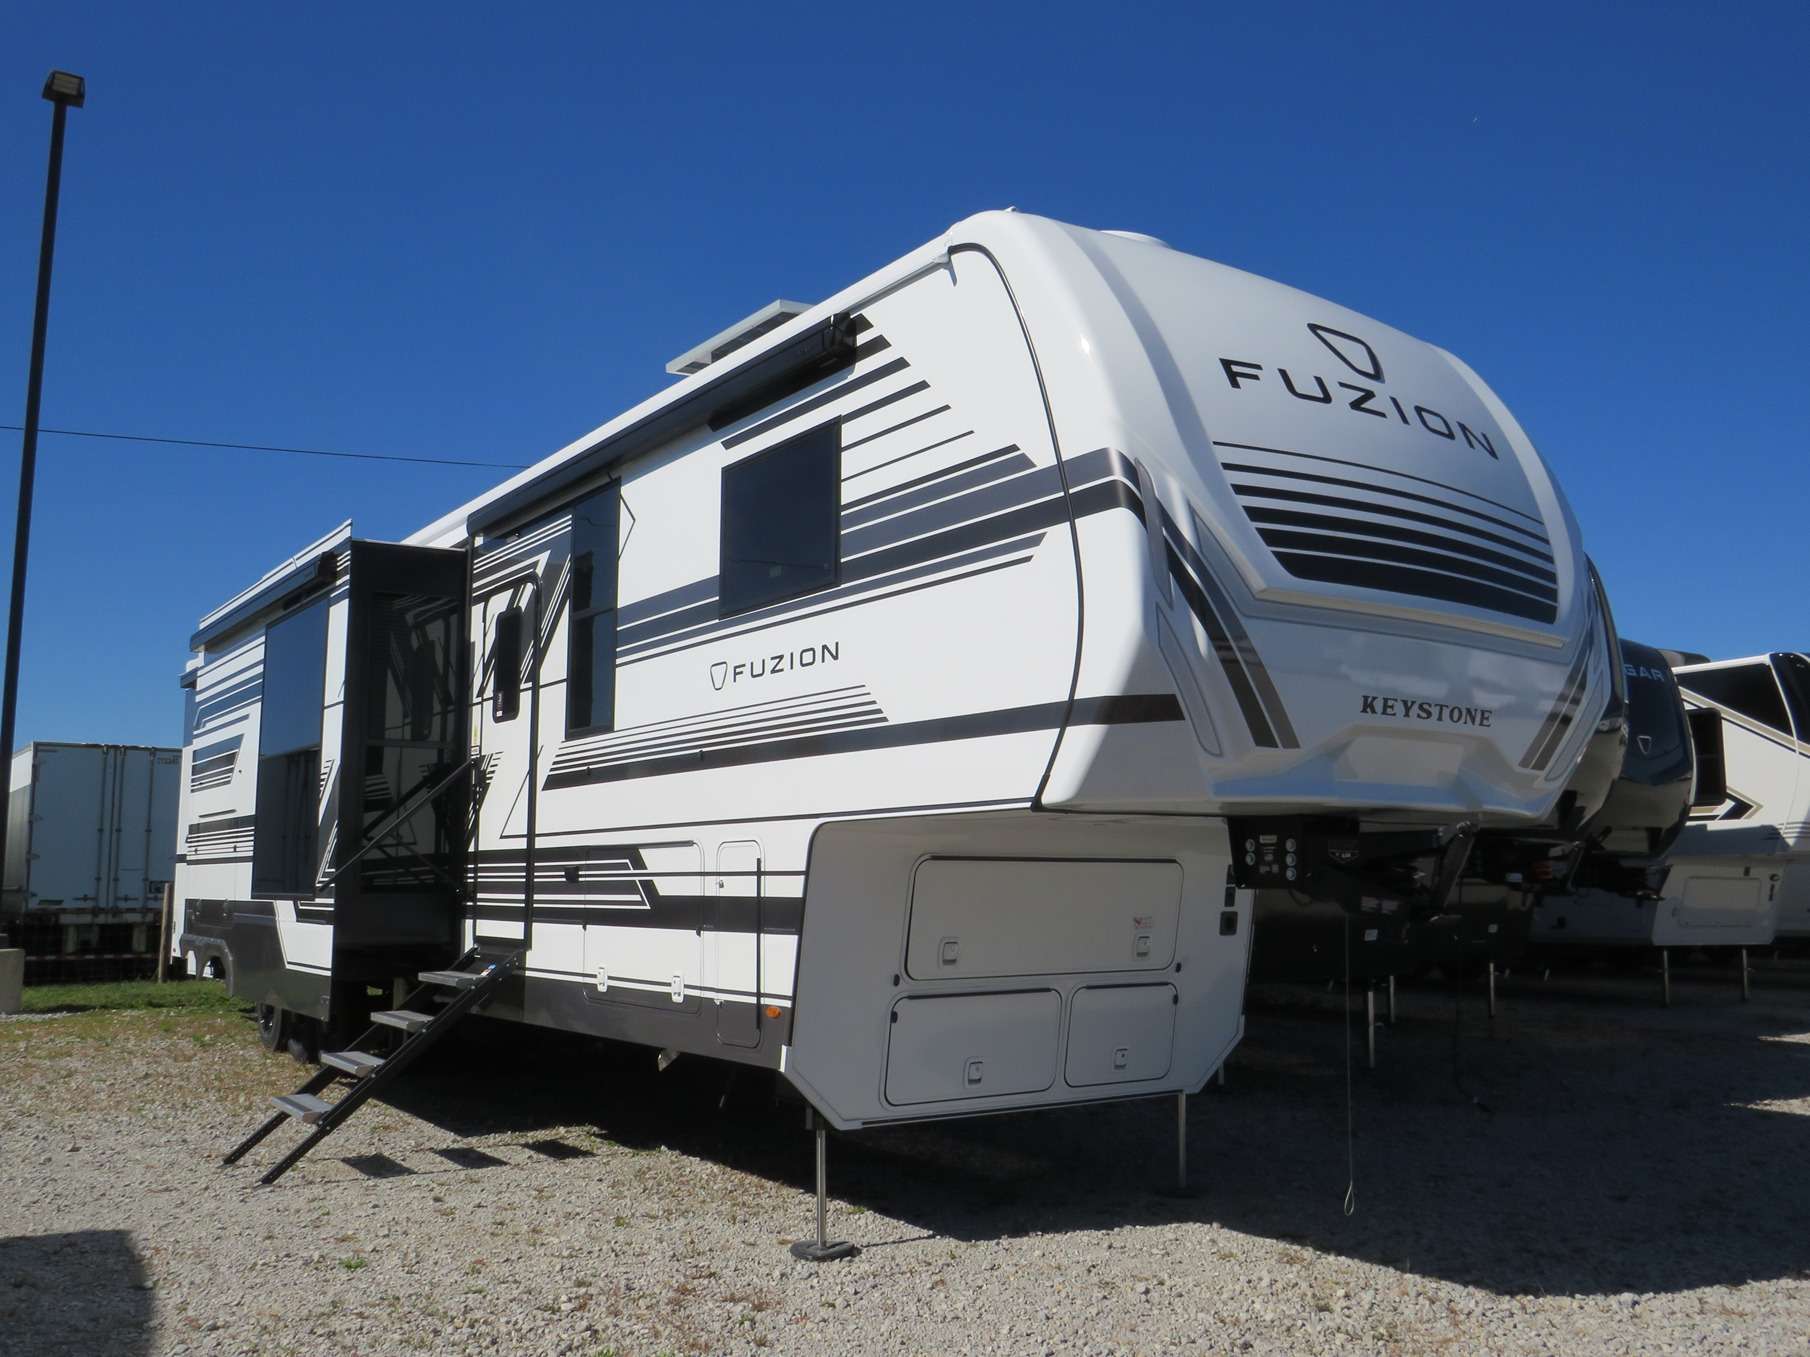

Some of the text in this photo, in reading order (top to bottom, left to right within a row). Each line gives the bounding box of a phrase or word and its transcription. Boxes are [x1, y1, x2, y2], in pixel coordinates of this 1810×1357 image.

[1219, 357, 1499, 460] FUZION
[733, 641, 839, 682] FUZION
[1360, 695, 1493, 727] KEYSTONE
